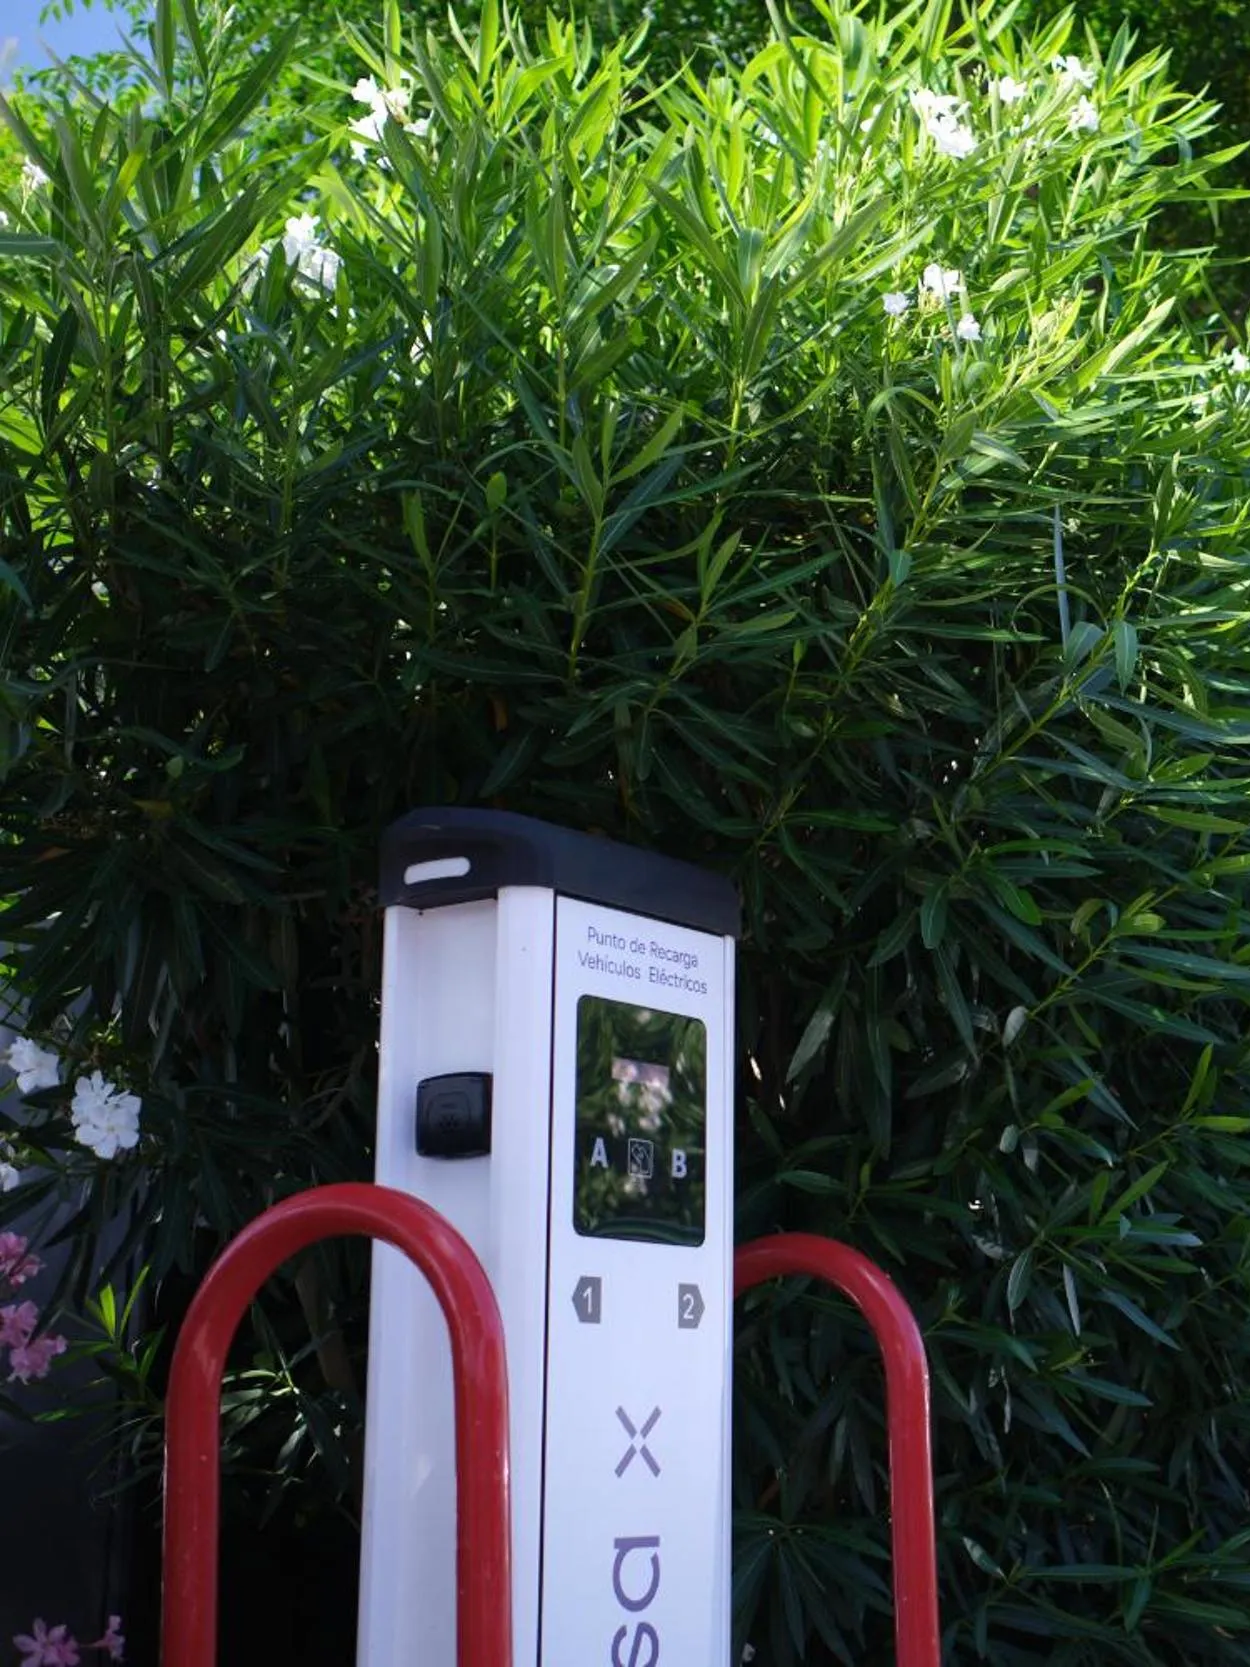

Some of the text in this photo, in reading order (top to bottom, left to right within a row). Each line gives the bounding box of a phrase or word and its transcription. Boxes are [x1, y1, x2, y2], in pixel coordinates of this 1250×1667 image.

[588, 926, 699, 970] Punto de Recarga
[578, 949, 708, 994] Vehículos Eléctricos
[590, 1137, 609, 1168] A
[671, 1149, 688, 1178] B
[583, 1286, 593, 1315] 1
[682, 1294, 695, 1320] 2
